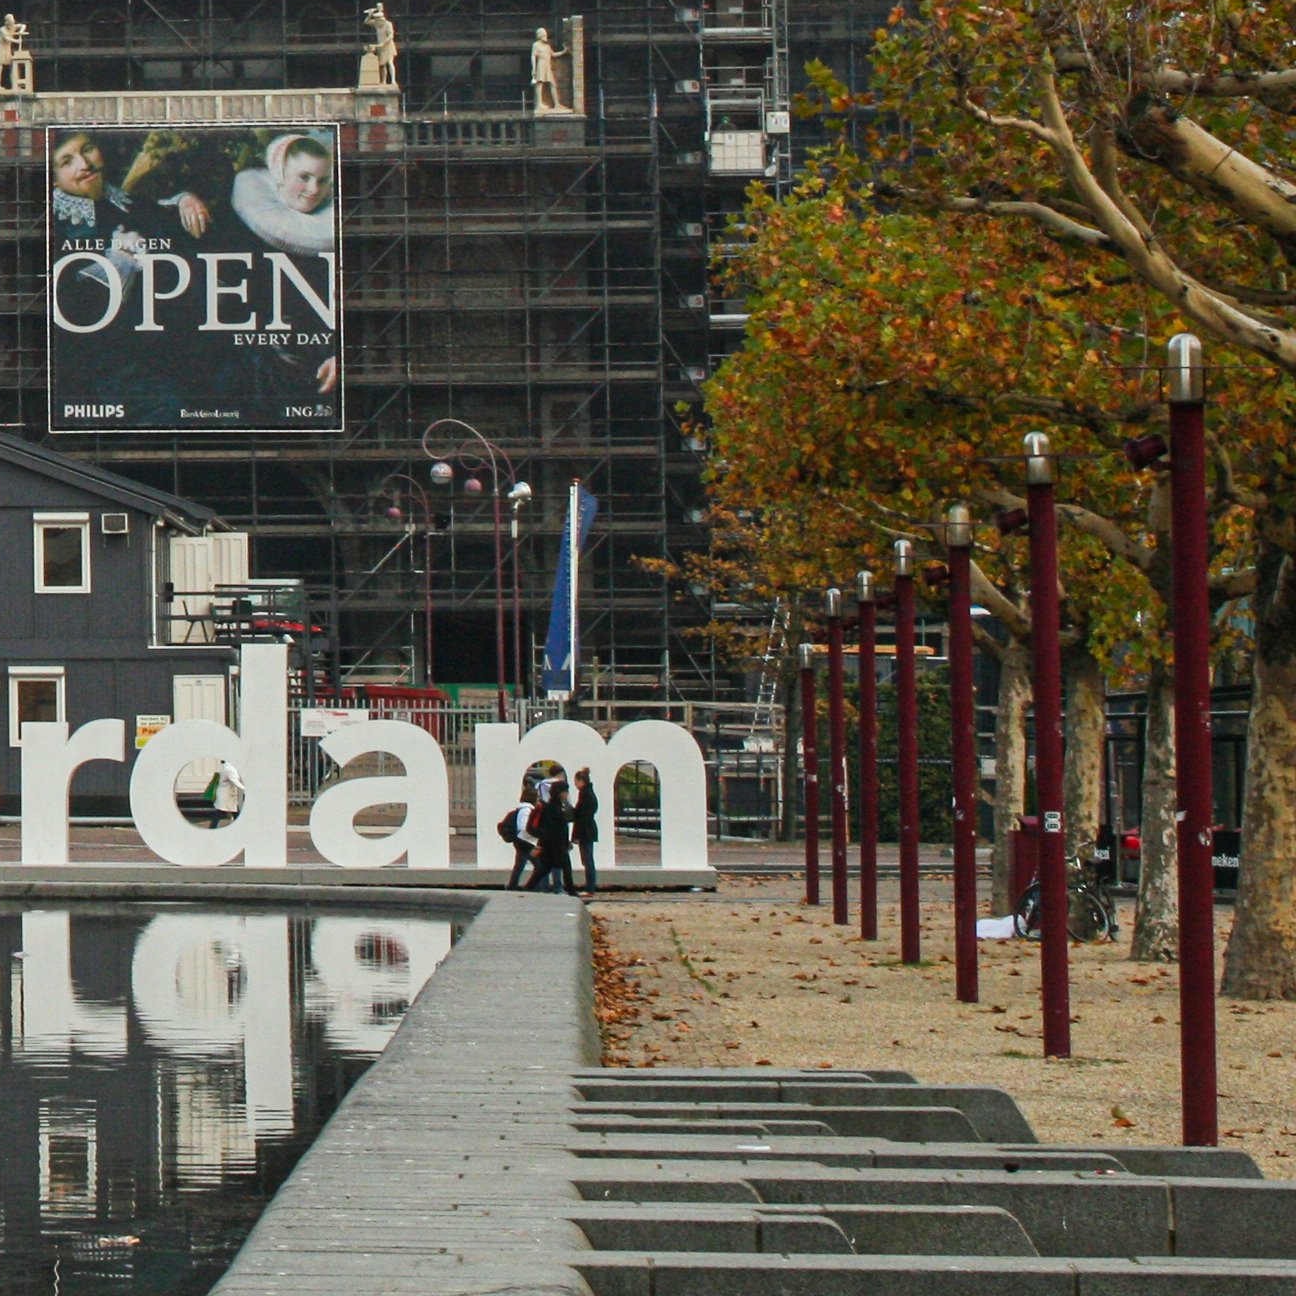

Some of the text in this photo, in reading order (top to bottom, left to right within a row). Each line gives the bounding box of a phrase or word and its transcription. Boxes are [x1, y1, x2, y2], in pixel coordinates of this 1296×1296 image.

[61, 238, 172, 251] ALLE DAGEN
[53, 252, 336, 334] OPEN
[233, 333, 333, 345] EVERY DAY
[64, 405, 125, 418] PHILIPS
[285, 406, 313, 418] ING
